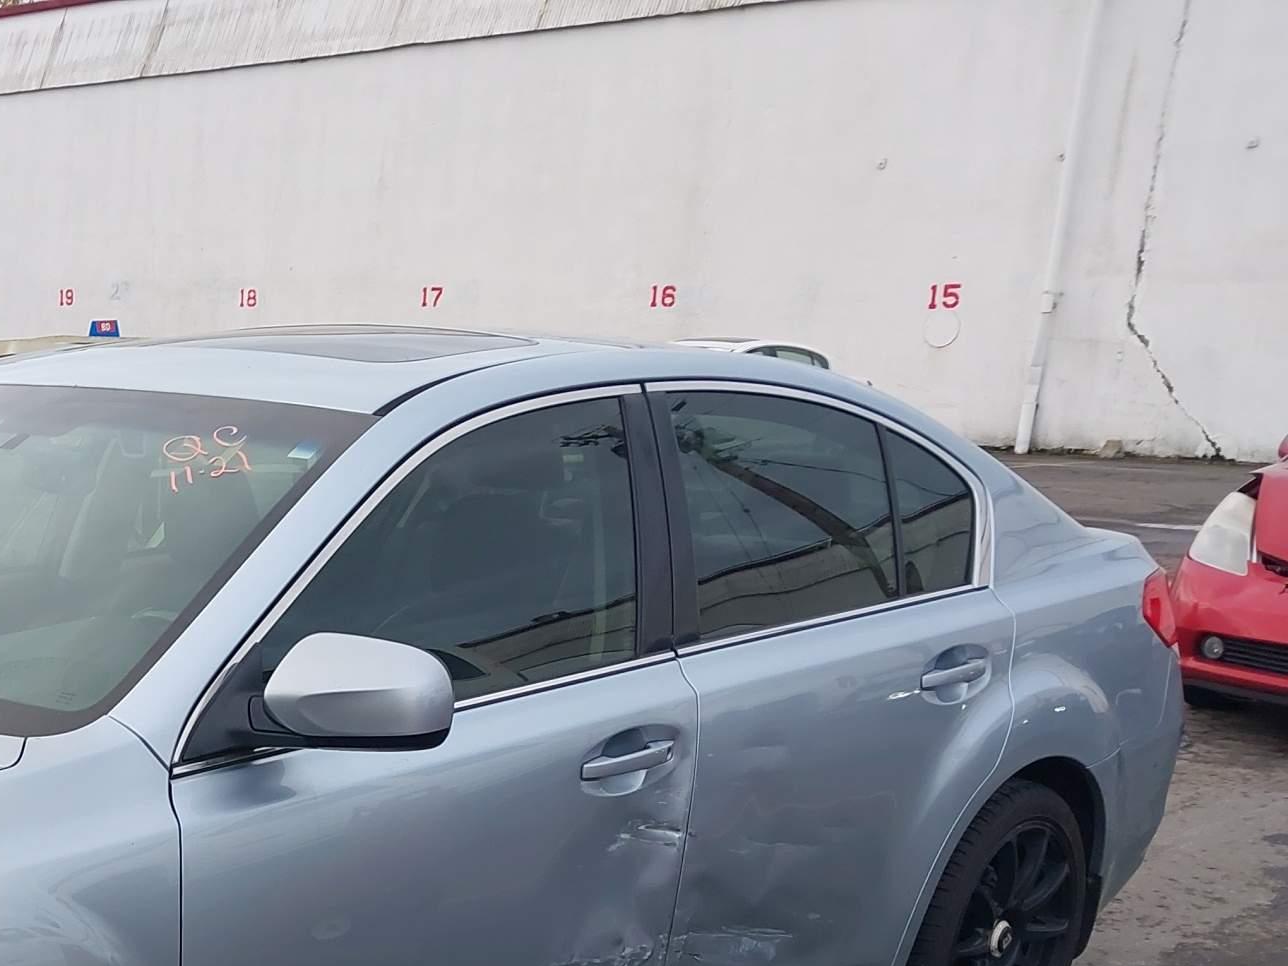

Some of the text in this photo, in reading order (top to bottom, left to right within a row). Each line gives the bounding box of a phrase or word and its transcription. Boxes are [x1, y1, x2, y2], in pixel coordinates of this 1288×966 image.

[58, 289, 75, 306] 19
[239, 288, 258, 308] 18
[422, 287, 444, 307] 17
[650, 285, 676, 307] 16
[928, 284, 961, 309] 15
